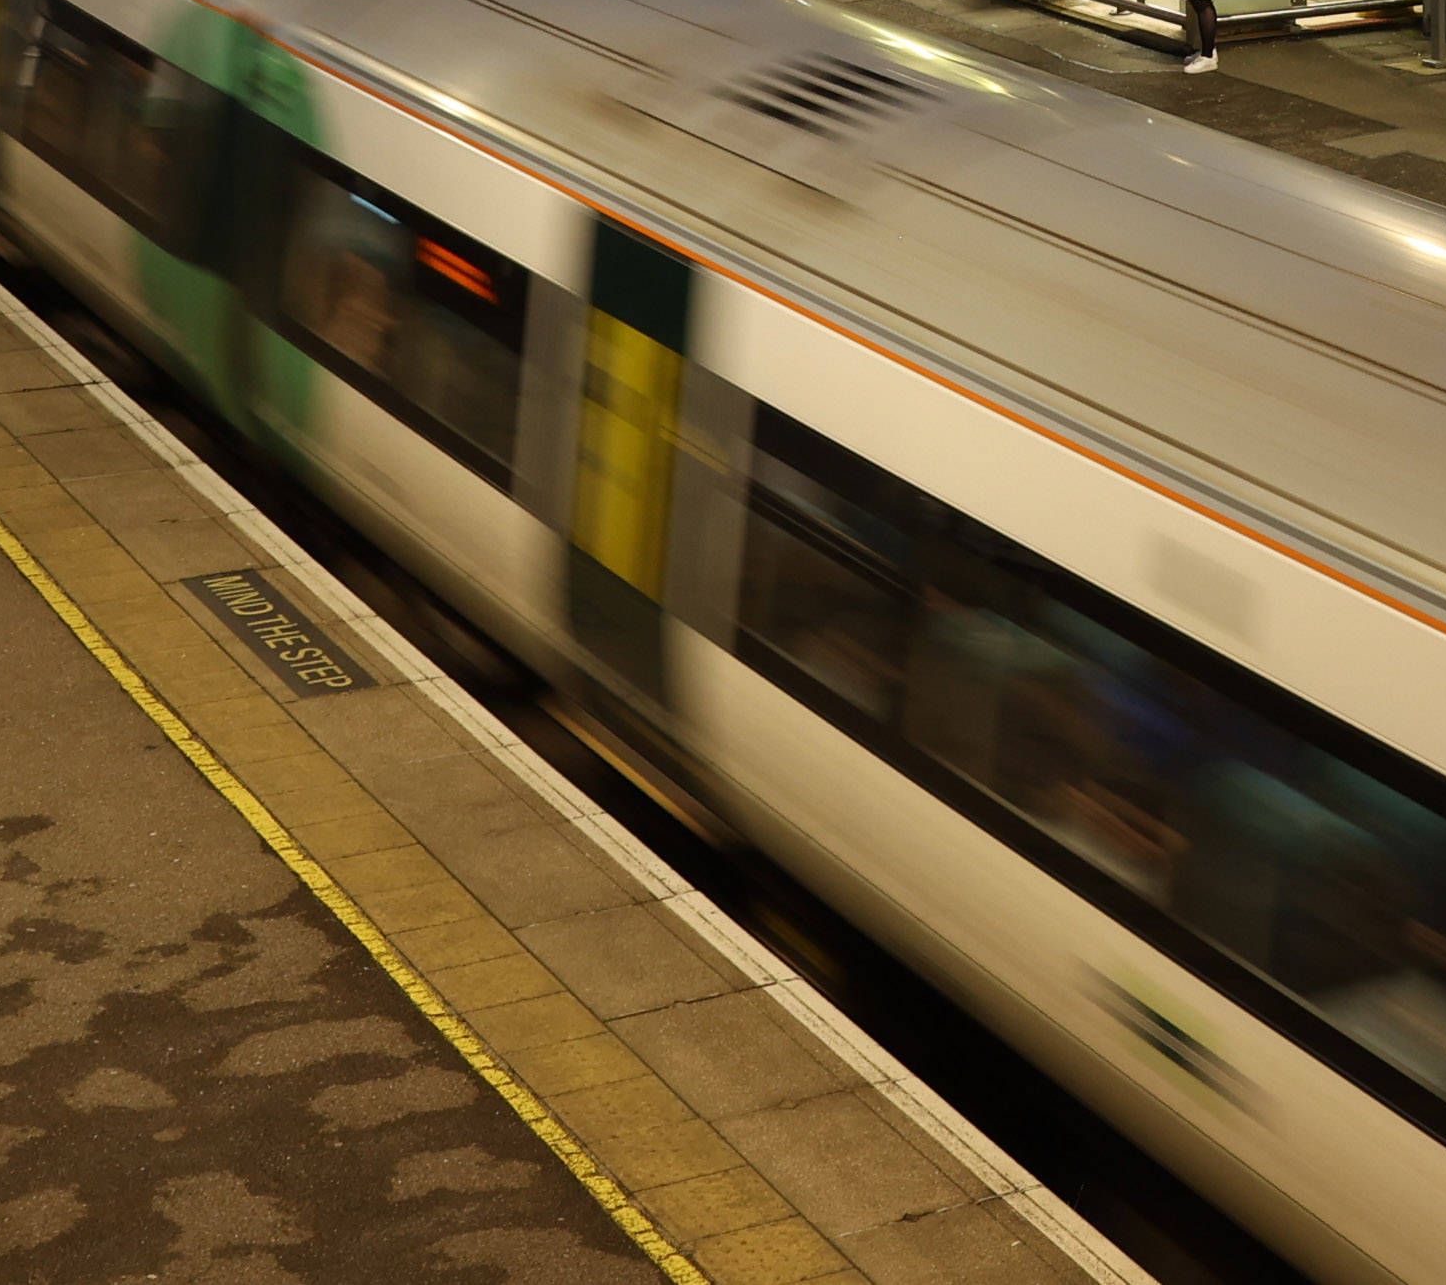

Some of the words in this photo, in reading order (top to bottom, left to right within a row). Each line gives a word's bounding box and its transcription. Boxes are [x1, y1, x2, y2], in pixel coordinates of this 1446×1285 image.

[202, 575, 274, 616] MIND
[246, 613, 311, 649] THE
[279, 647, 354, 688] STEP
